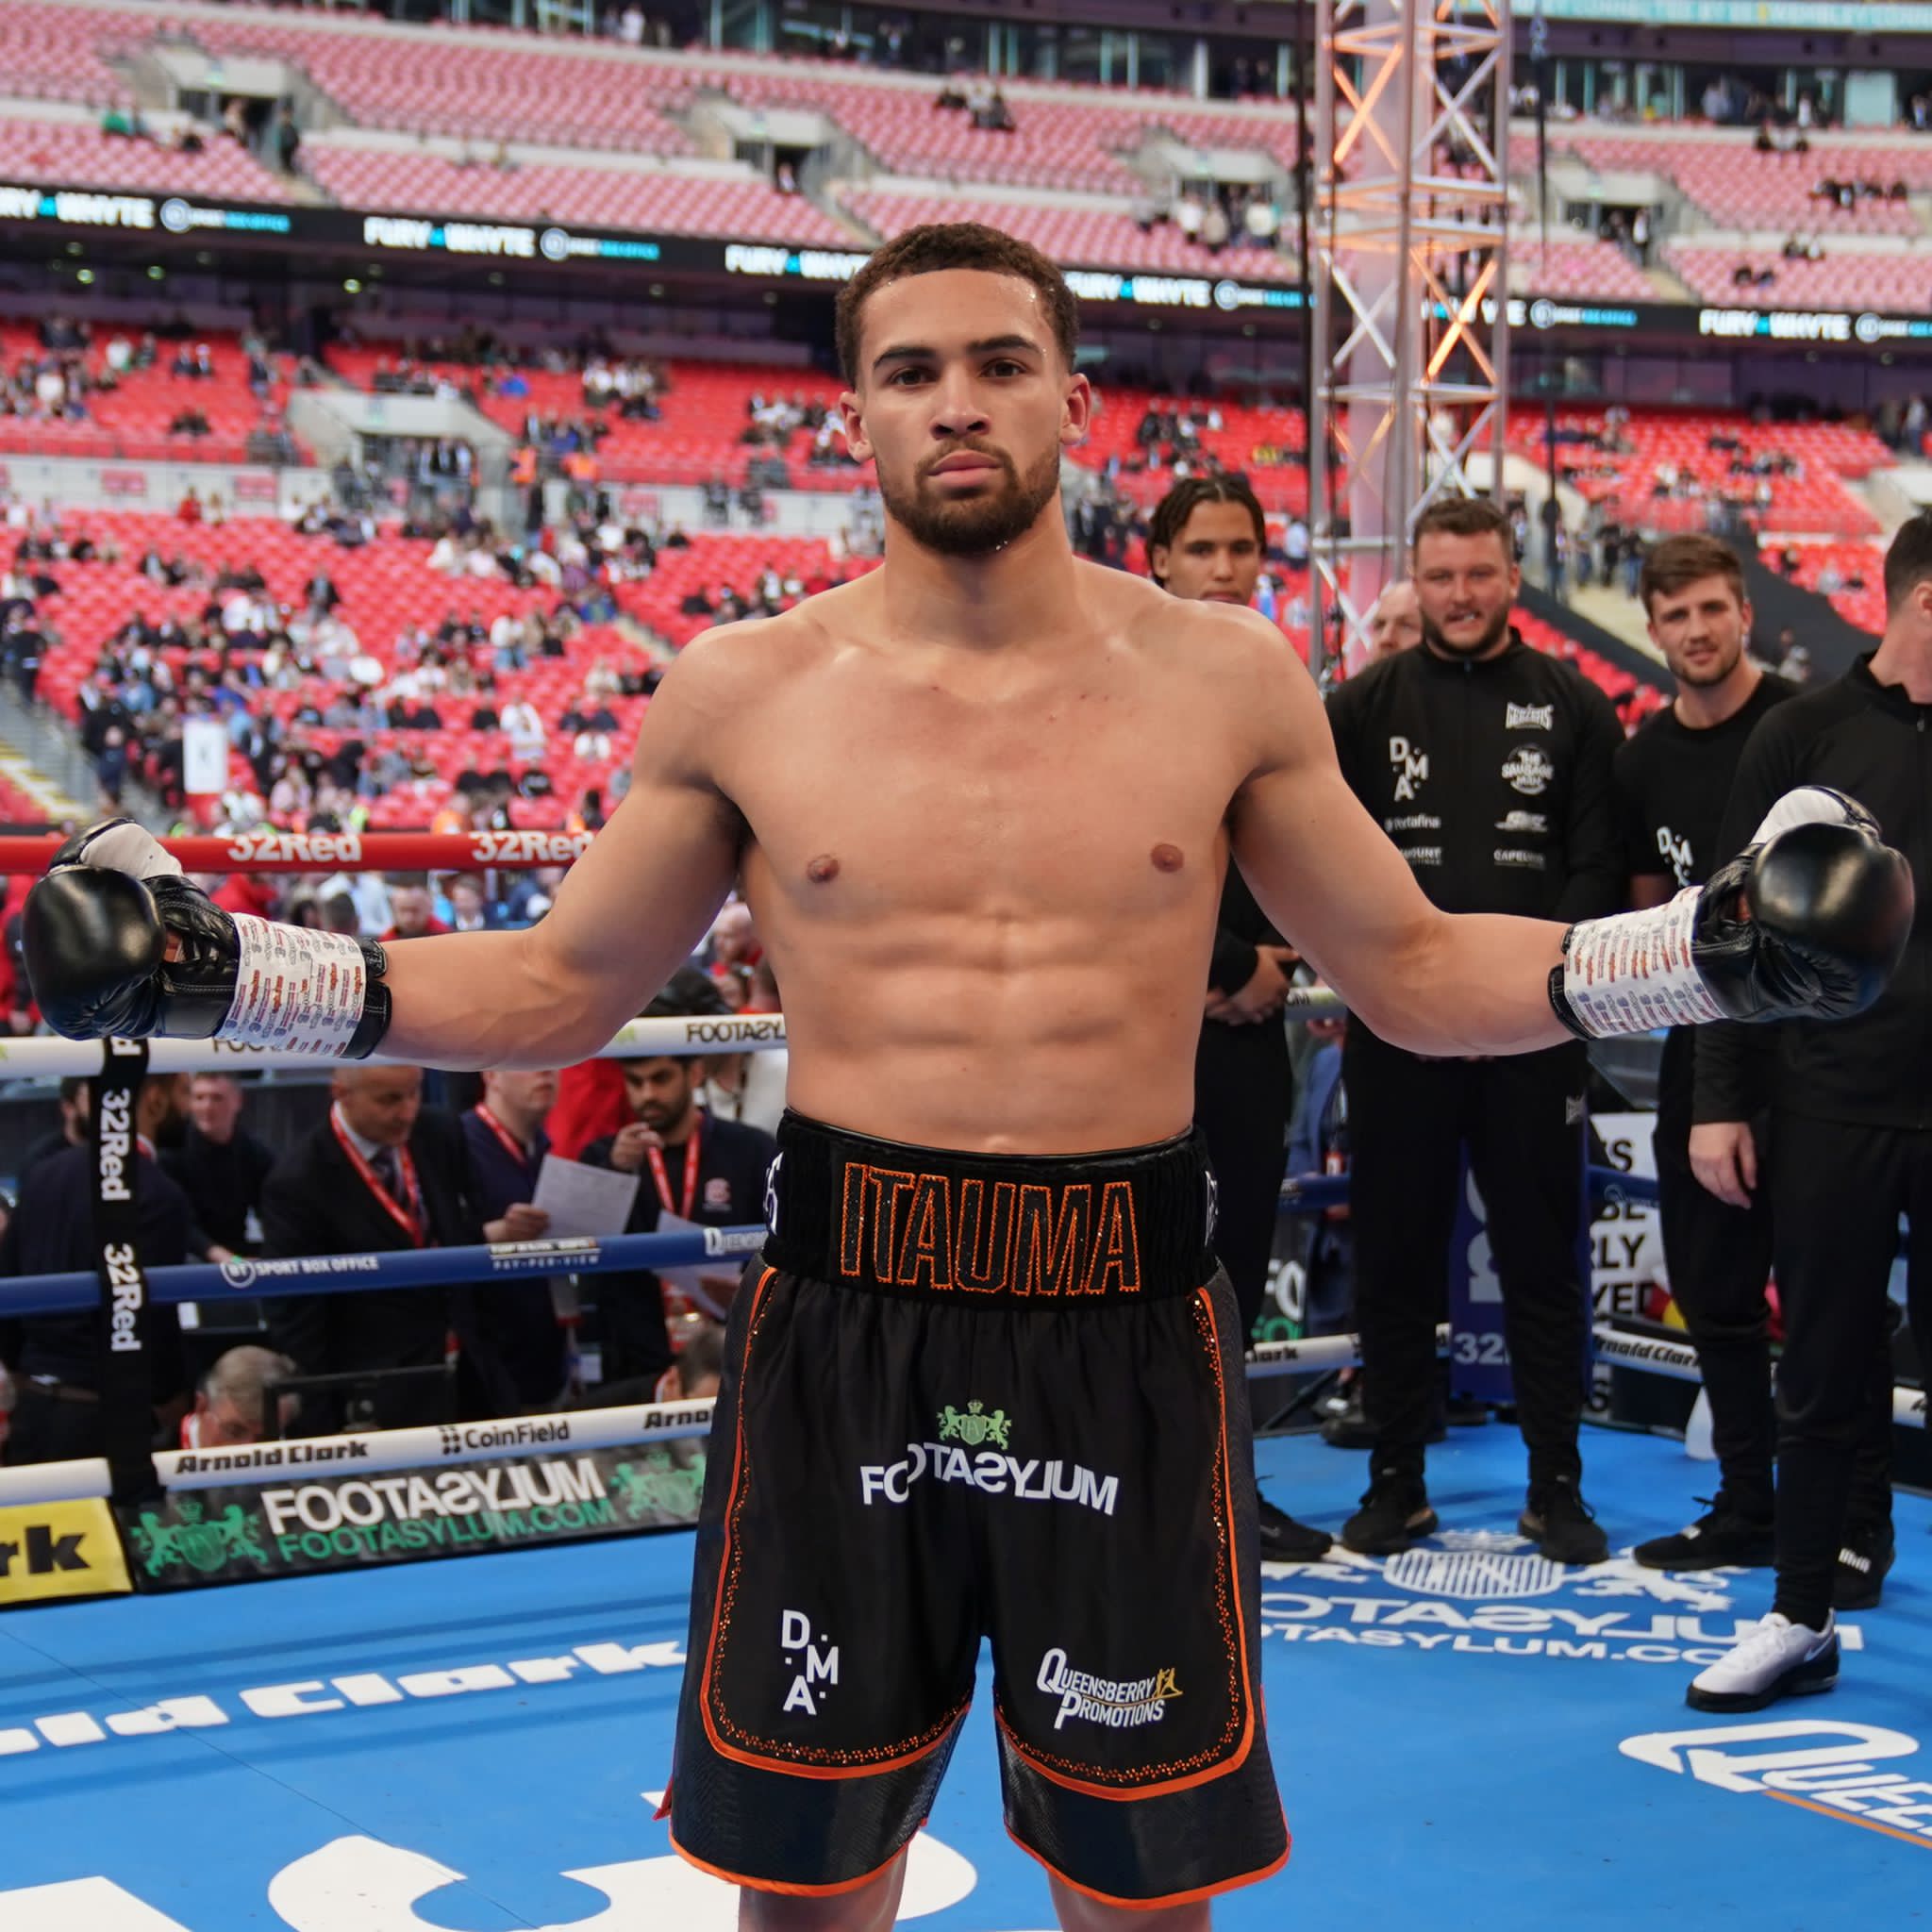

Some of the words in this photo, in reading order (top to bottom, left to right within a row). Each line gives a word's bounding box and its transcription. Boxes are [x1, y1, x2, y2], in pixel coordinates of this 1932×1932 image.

[227, 834, 362, 862] 32Red
[99, 1088, 131, 1201] 32Red
[840, 1161, 1141, 1297] ITAUMA
[103, 1243, 142, 1352] 32Red
[1454, 1332, 1511, 1365] 32
[465, 1421, 571, 1449] CoinField
[643, 1410, 710, 1429] Arno
[175, 1447, 282, 1474] Arnold
[288, 1441, 369, 1464] Clark
[261, 1457, 607, 1536] FOOTASYLUM
[276, 1498, 617, 1563] FOOTASYLUM.COM
[1261, 1592, 1865, 1651] OTASYLU
[1261, 1623, 1728, 1666] TASYLUM.CO
[239, 1640, 689, 1718] Clark
[1037, 1647, 1156, 1704] QUEENSBERRY
[1054, 1689, 1165, 1730] PROMOTIONS
[1618, 1719, 1932, 1837] QUEE
